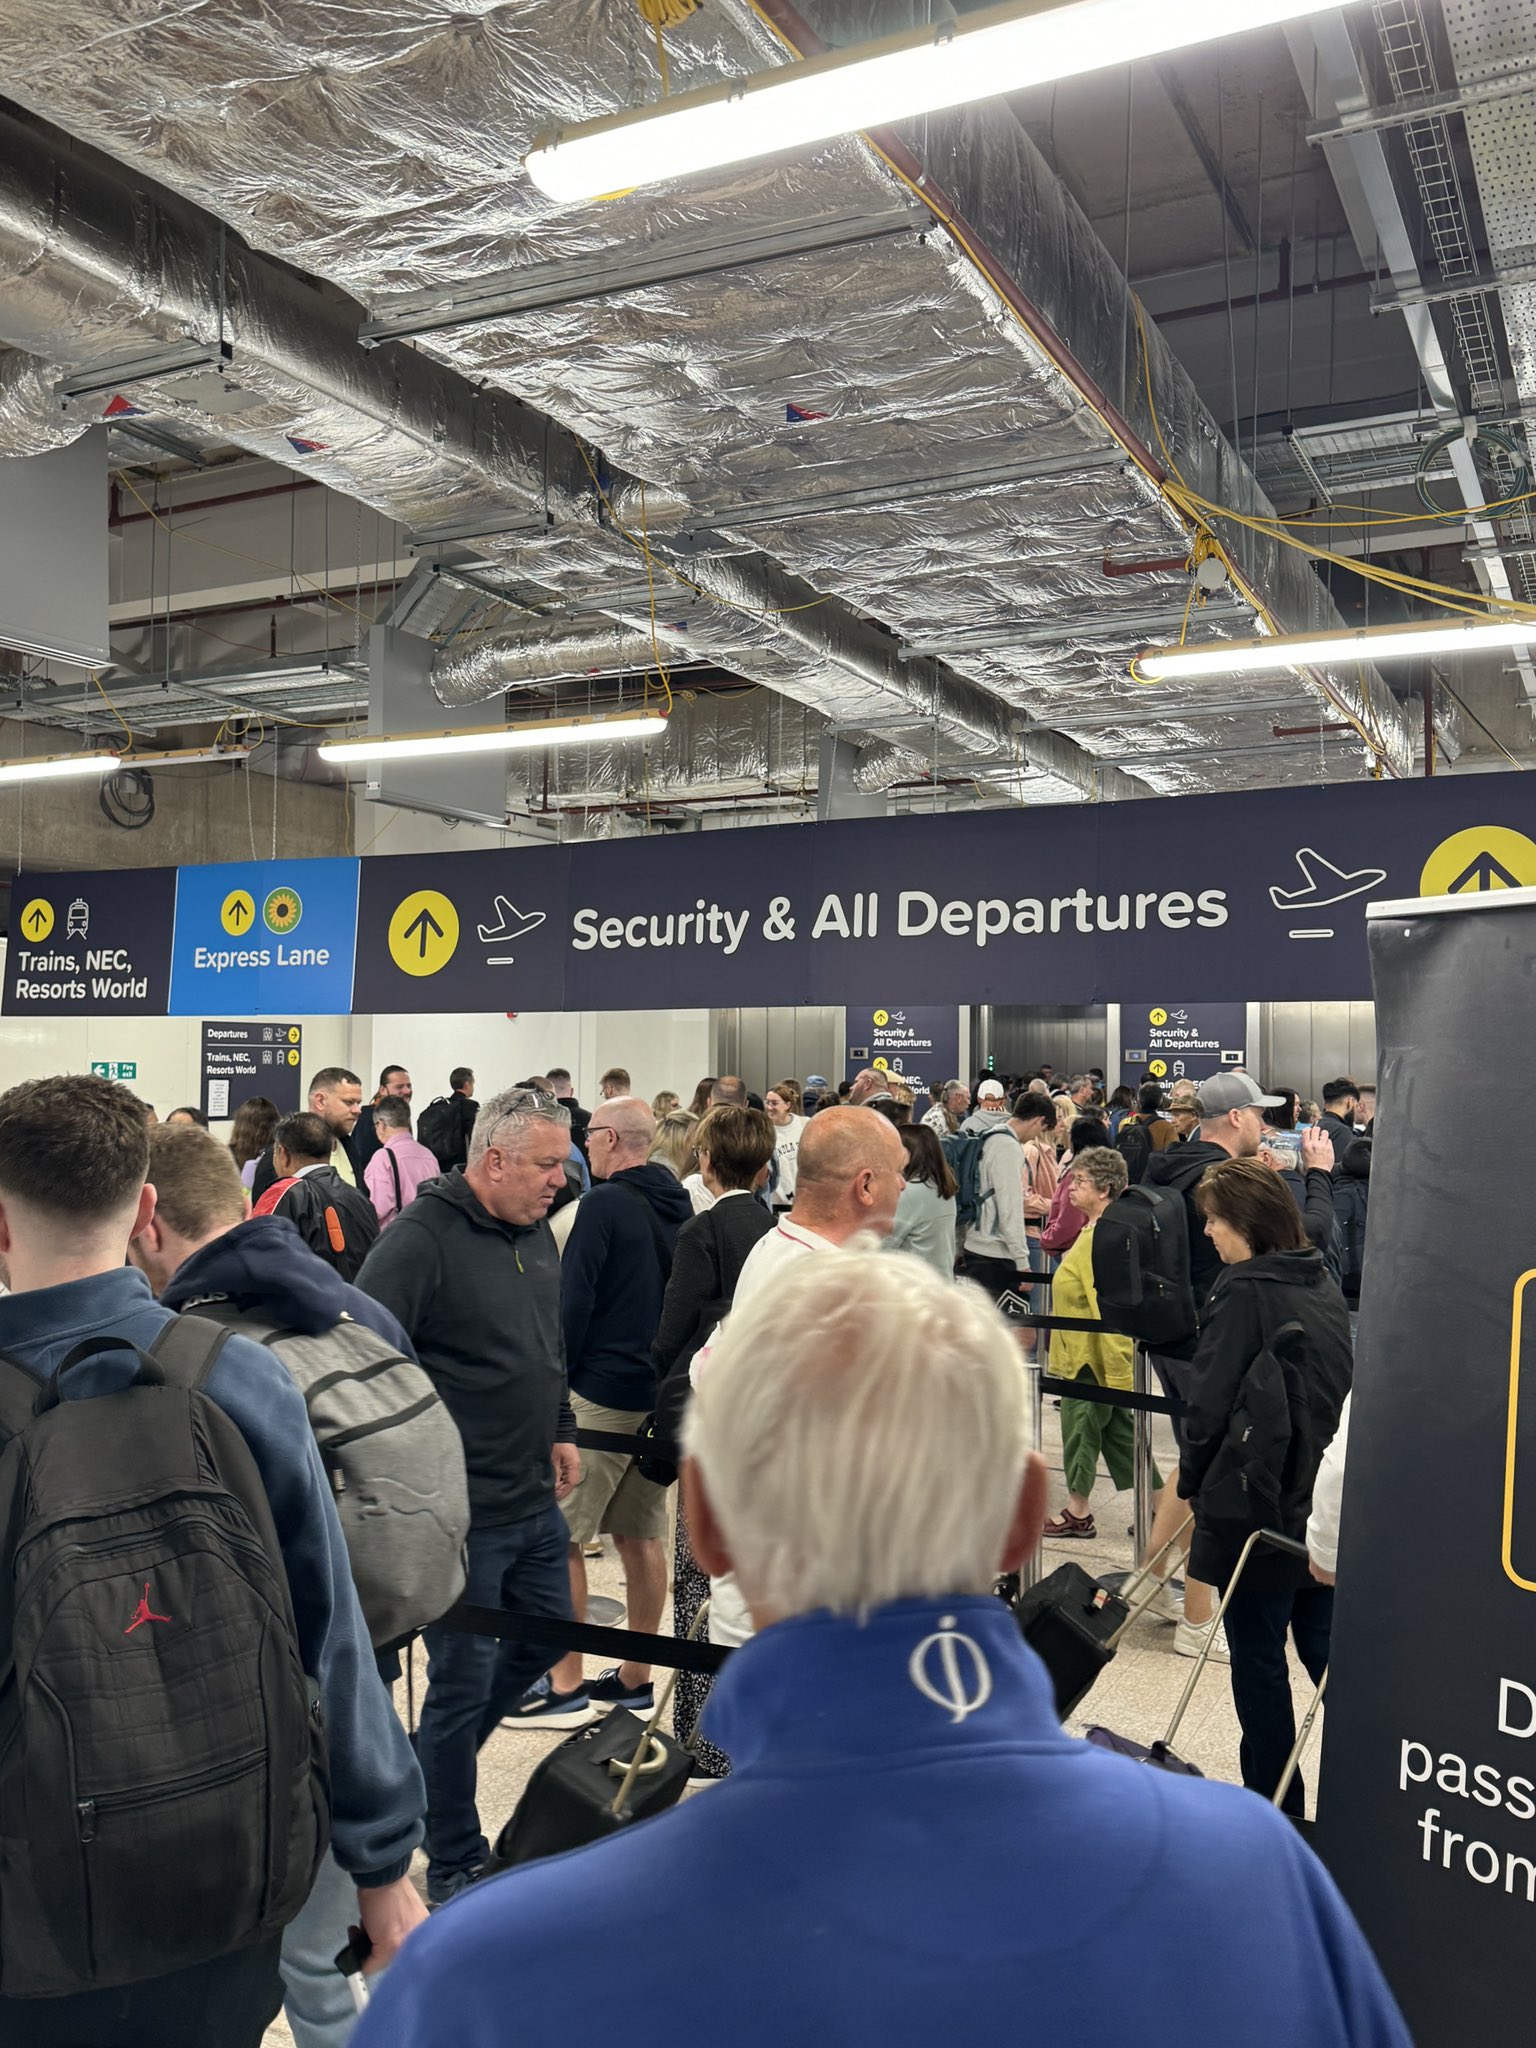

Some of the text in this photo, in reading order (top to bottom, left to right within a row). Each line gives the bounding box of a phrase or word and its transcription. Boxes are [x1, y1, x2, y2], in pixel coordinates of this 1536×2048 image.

[572, 888, 1229, 955] Security & All Departures
[18, 949, 132, 974] Trains, NEC,
[194, 944, 330, 973] Express Lane
[15, 976, 148, 999] Resorts World
[207, 1028, 248, 1040] Departures
[873, 1028, 915, 1039] Security &
[1149, 1028, 1199, 1040] Security &
[873, 1038, 932, 1048] All Departures
[1149, 1039, 1220, 1050] All Departures
[206, 1052, 251, 1063] Trains, NEC,
[206, 1065, 257, 1075] Resorts World
